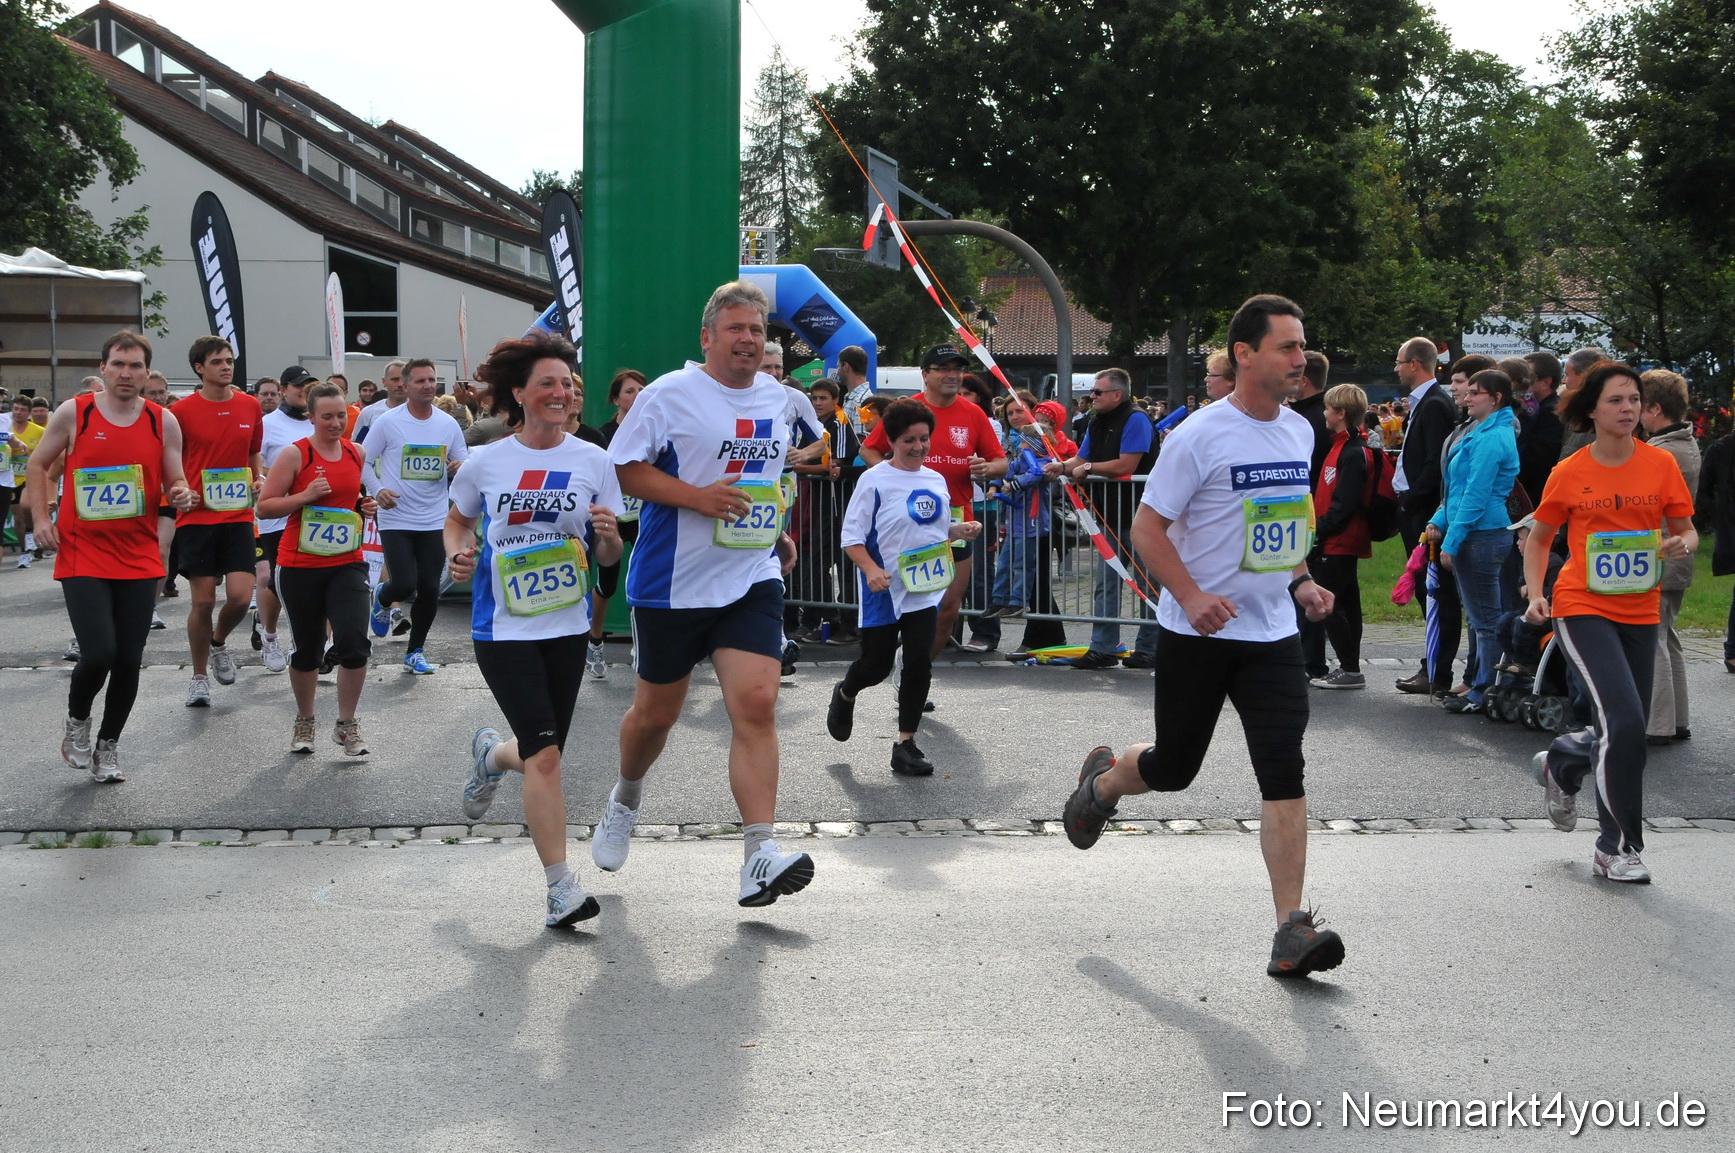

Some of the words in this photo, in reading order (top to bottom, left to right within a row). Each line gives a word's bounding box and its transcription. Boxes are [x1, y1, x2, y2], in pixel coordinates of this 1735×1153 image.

[717, 440, 780, 460] PERRAS
[733, 439, 771, 447] AUTOHAUS
[404, 457, 440, 471] 1032
[923, 454, 968, 465] adt-Team
[1249, 467, 1309, 483] STAEDTLER
[82, 483, 130, 507] 742
[206, 482, 247, 500] 1142
[512, 490, 566, 498] AUTOHAUS
[497, 491, 578, 513] PERRAS
[915, 500, 935, 510] TÜV
[1578, 498, 1613, 511] EURO
[1625, 494, 1659, 507] POLES
[308, 522, 349, 545] 743
[1252, 520, 1297, 554] 891
[906, 558, 945, 586] 714
[1595, 552, 1649, 579] 605
[507, 563, 577, 600] 1253
[530, 597, 547, 605] Erna
